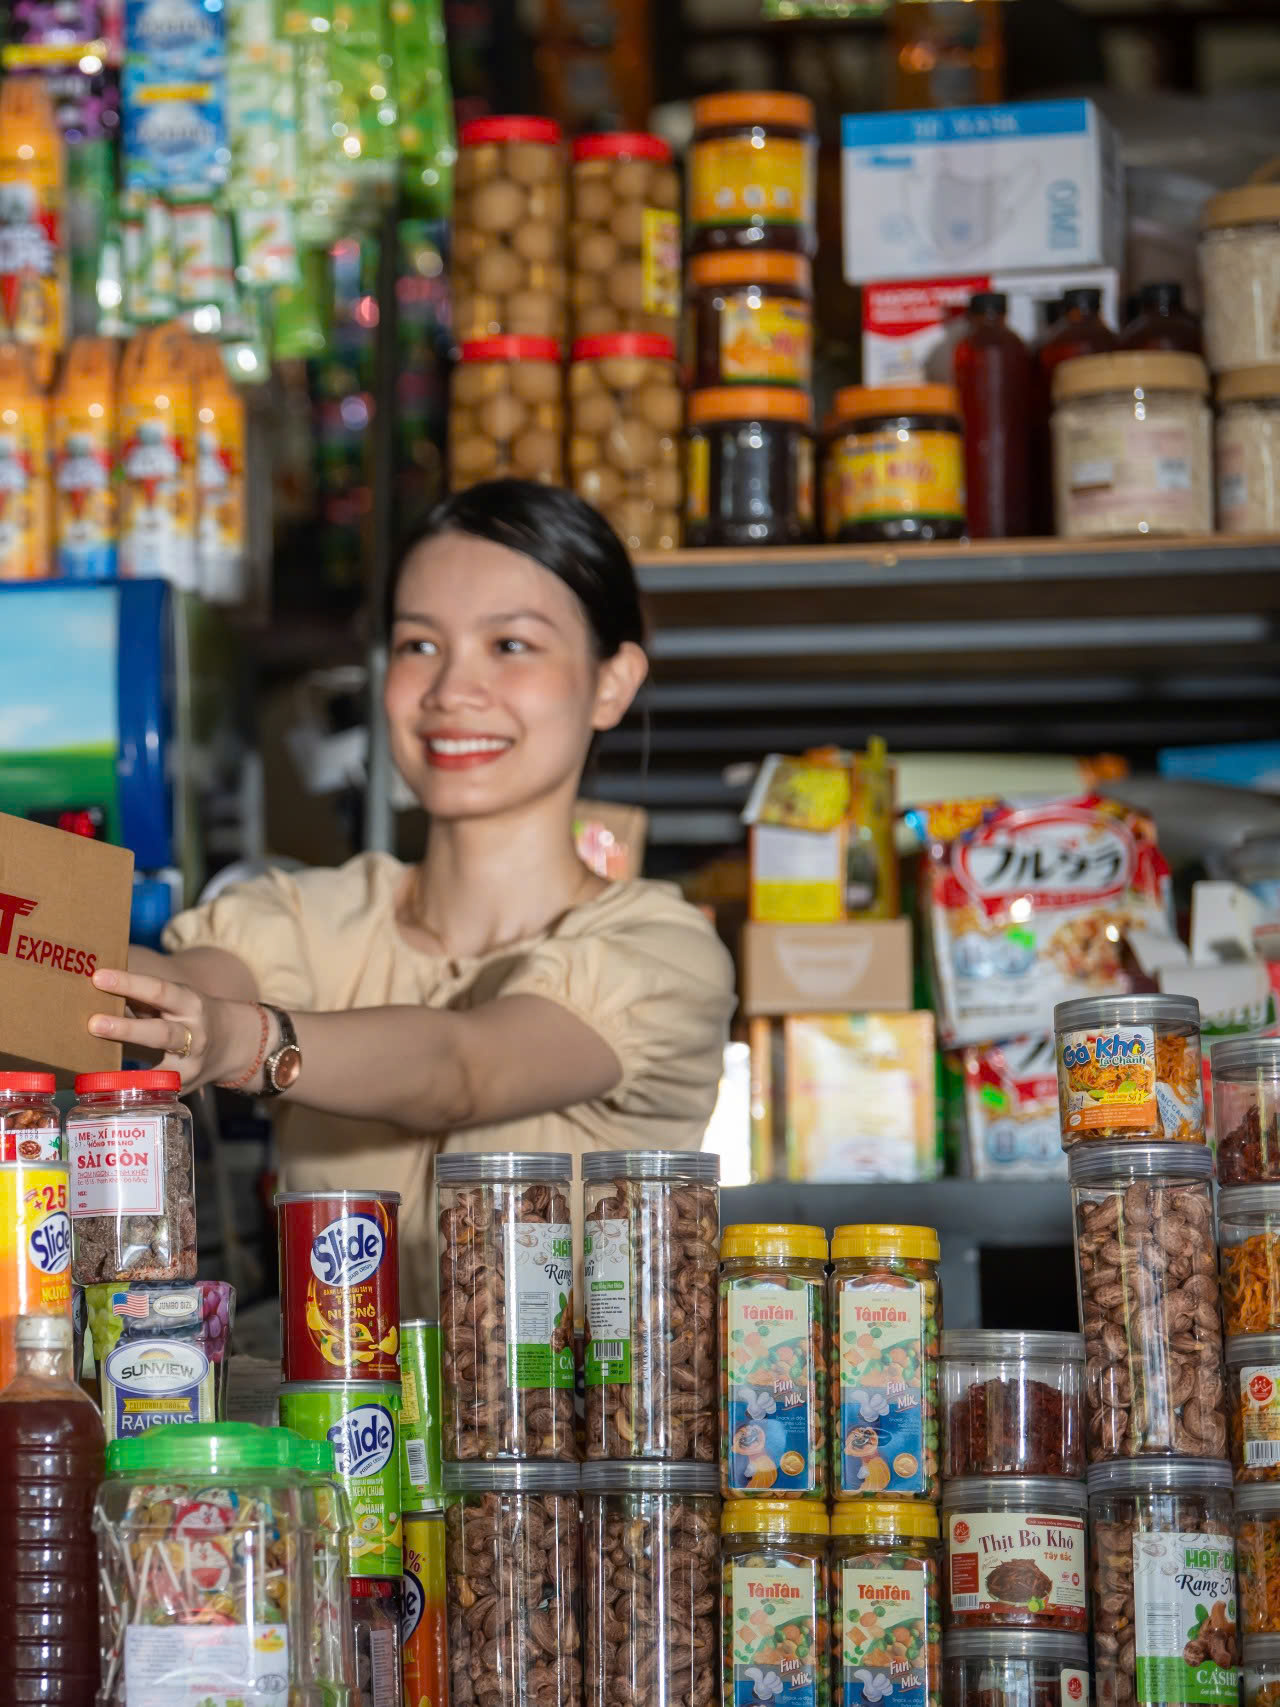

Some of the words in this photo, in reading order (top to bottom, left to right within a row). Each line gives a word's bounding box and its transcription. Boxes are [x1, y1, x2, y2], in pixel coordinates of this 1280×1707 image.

[16, 934, 97, 978] EXPRESS
[1063, 1042, 1091, 1067] Gà
[1095, 1033, 1146, 1060] Khô
[77, 1151, 101, 1169] SÀI
[105, 1149, 148, 1167] GÒN
[31, 1221, 70, 1269] Slide
[312, 1224, 379, 1282] Slide
[158, 1302, 179, 1310] JUMBO
[743, 1305, 794, 1321] TânTân
[855, 1306, 907, 1322] TânTân
[121, 1361, 195, 1380] SUNVIEW
[773, 1380, 794, 1394] Fun
[886, 1381, 907, 1395] Fun
[784, 1392, 805, 1408] Mix
[897, 1394, 918, 1409] Mix
[121, 1415, 195, 1431] RAISINS
[979, 1534, 1015, 1553] Thịt
[1019, 1530, 1041, 1547] Bò
[1046, 1529, 1074, 1550] Khô
[1184, 1549, 1222, 1573] HẠT
[747, 1582, 801, 1599] TânTân
[858, 1584, 911, 1600] TânTân
[1175, 1574, 1219, 1598] Rang
[780, 1658, 800, 1673] Fun
[890, 1659, 910, 1675] Fun
[791, 1671, 810, 1687] Mix
[901, 1674, 922, 1689] Mix
